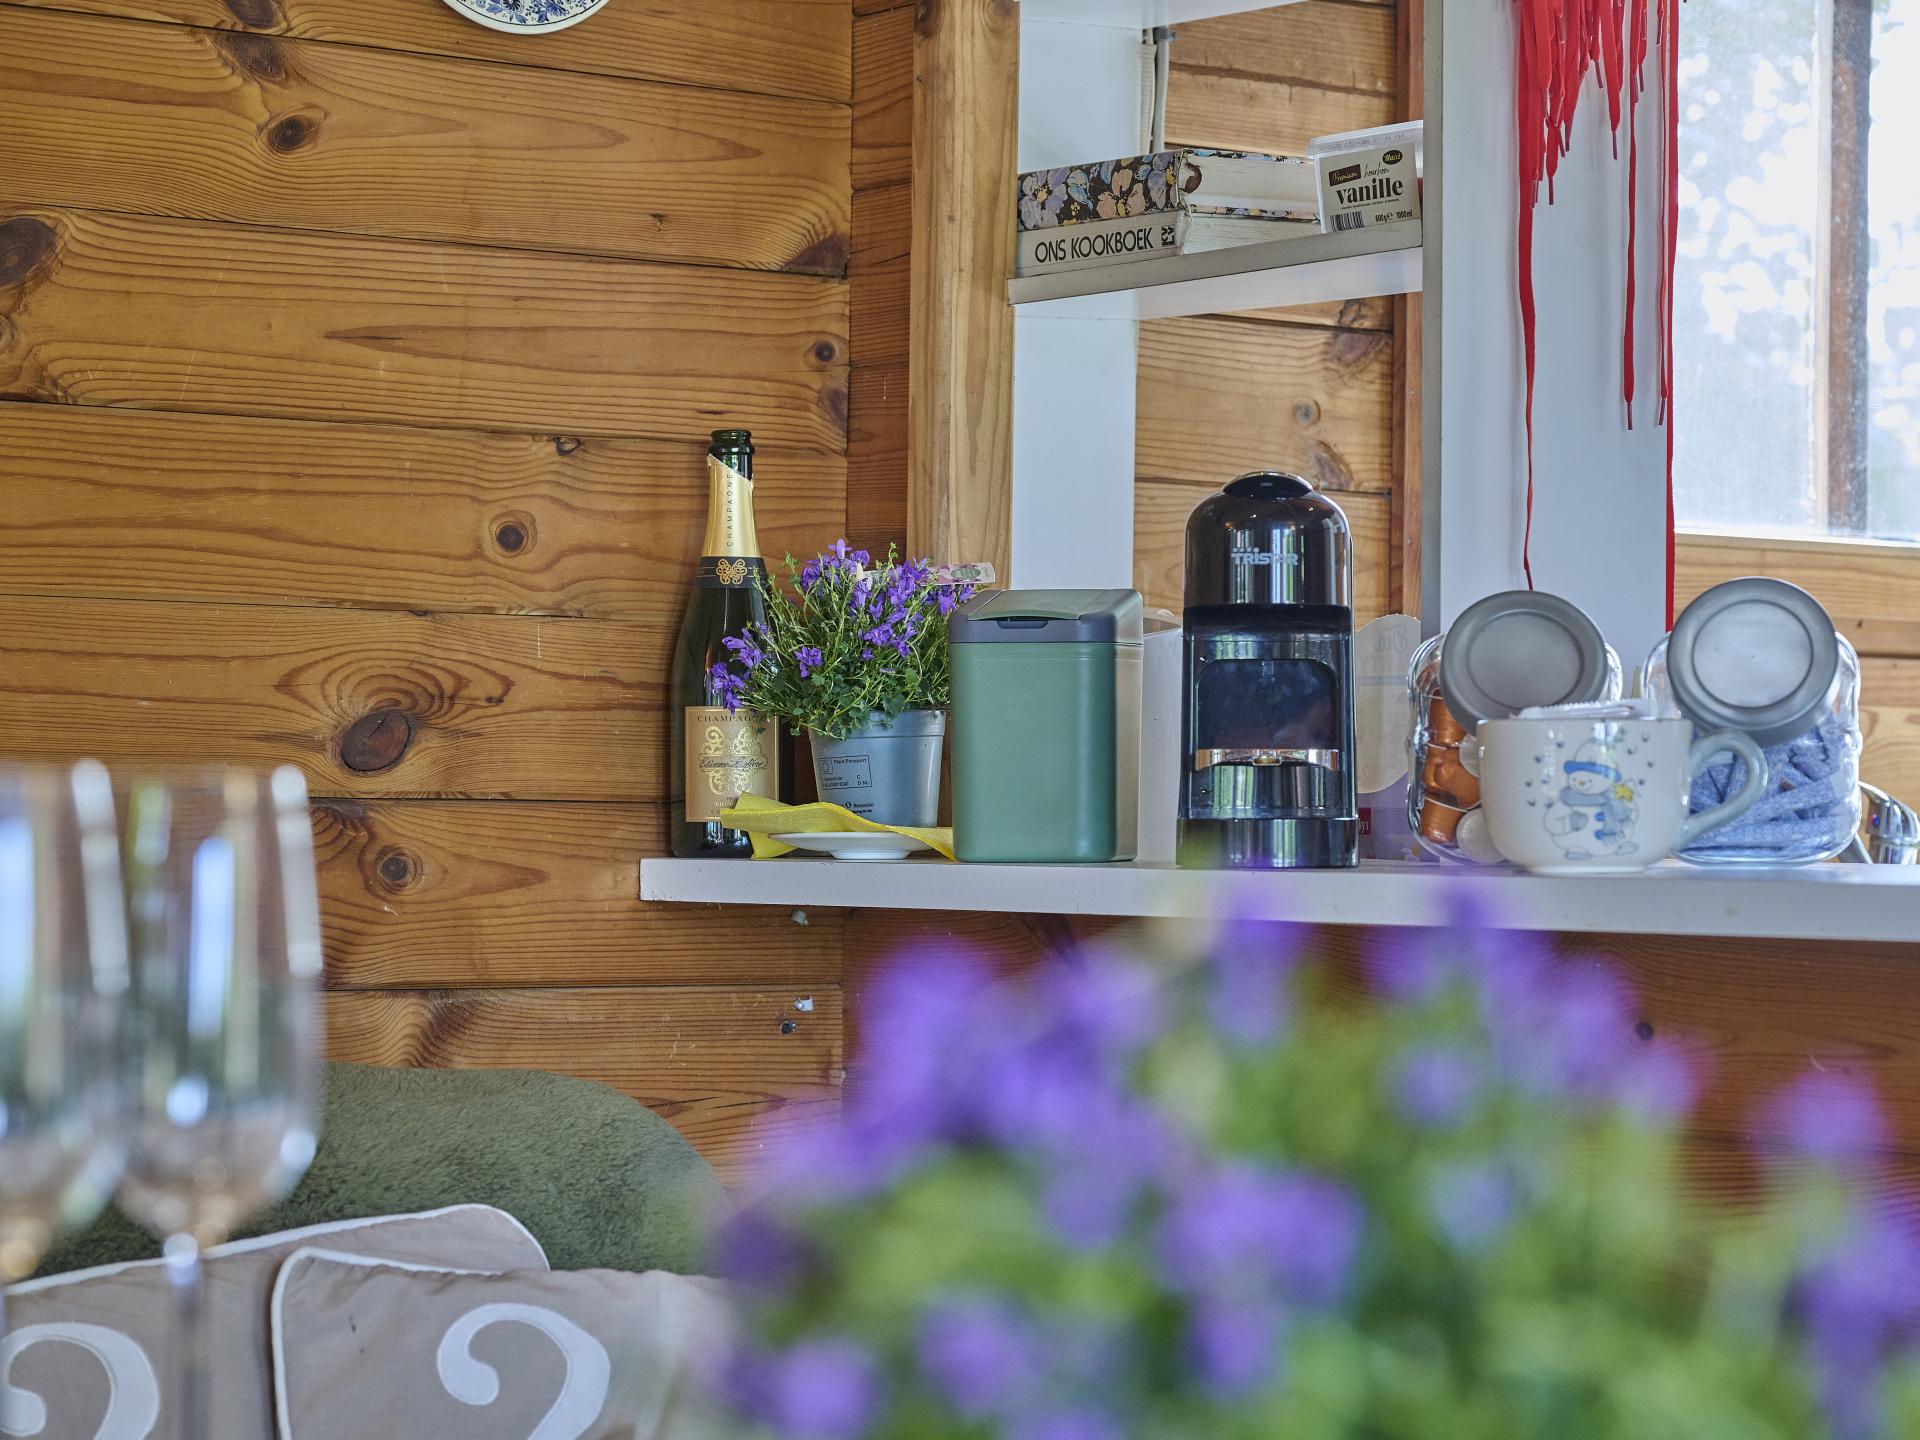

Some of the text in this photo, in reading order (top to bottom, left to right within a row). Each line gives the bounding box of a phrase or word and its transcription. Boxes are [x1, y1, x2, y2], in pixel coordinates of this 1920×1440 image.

[1336, 178, 1404, 205] vanille
[1035, 227, 1154, 263] ONS KOOKBOEK
[726, 474, 734, 547] CHAMPAGNE
